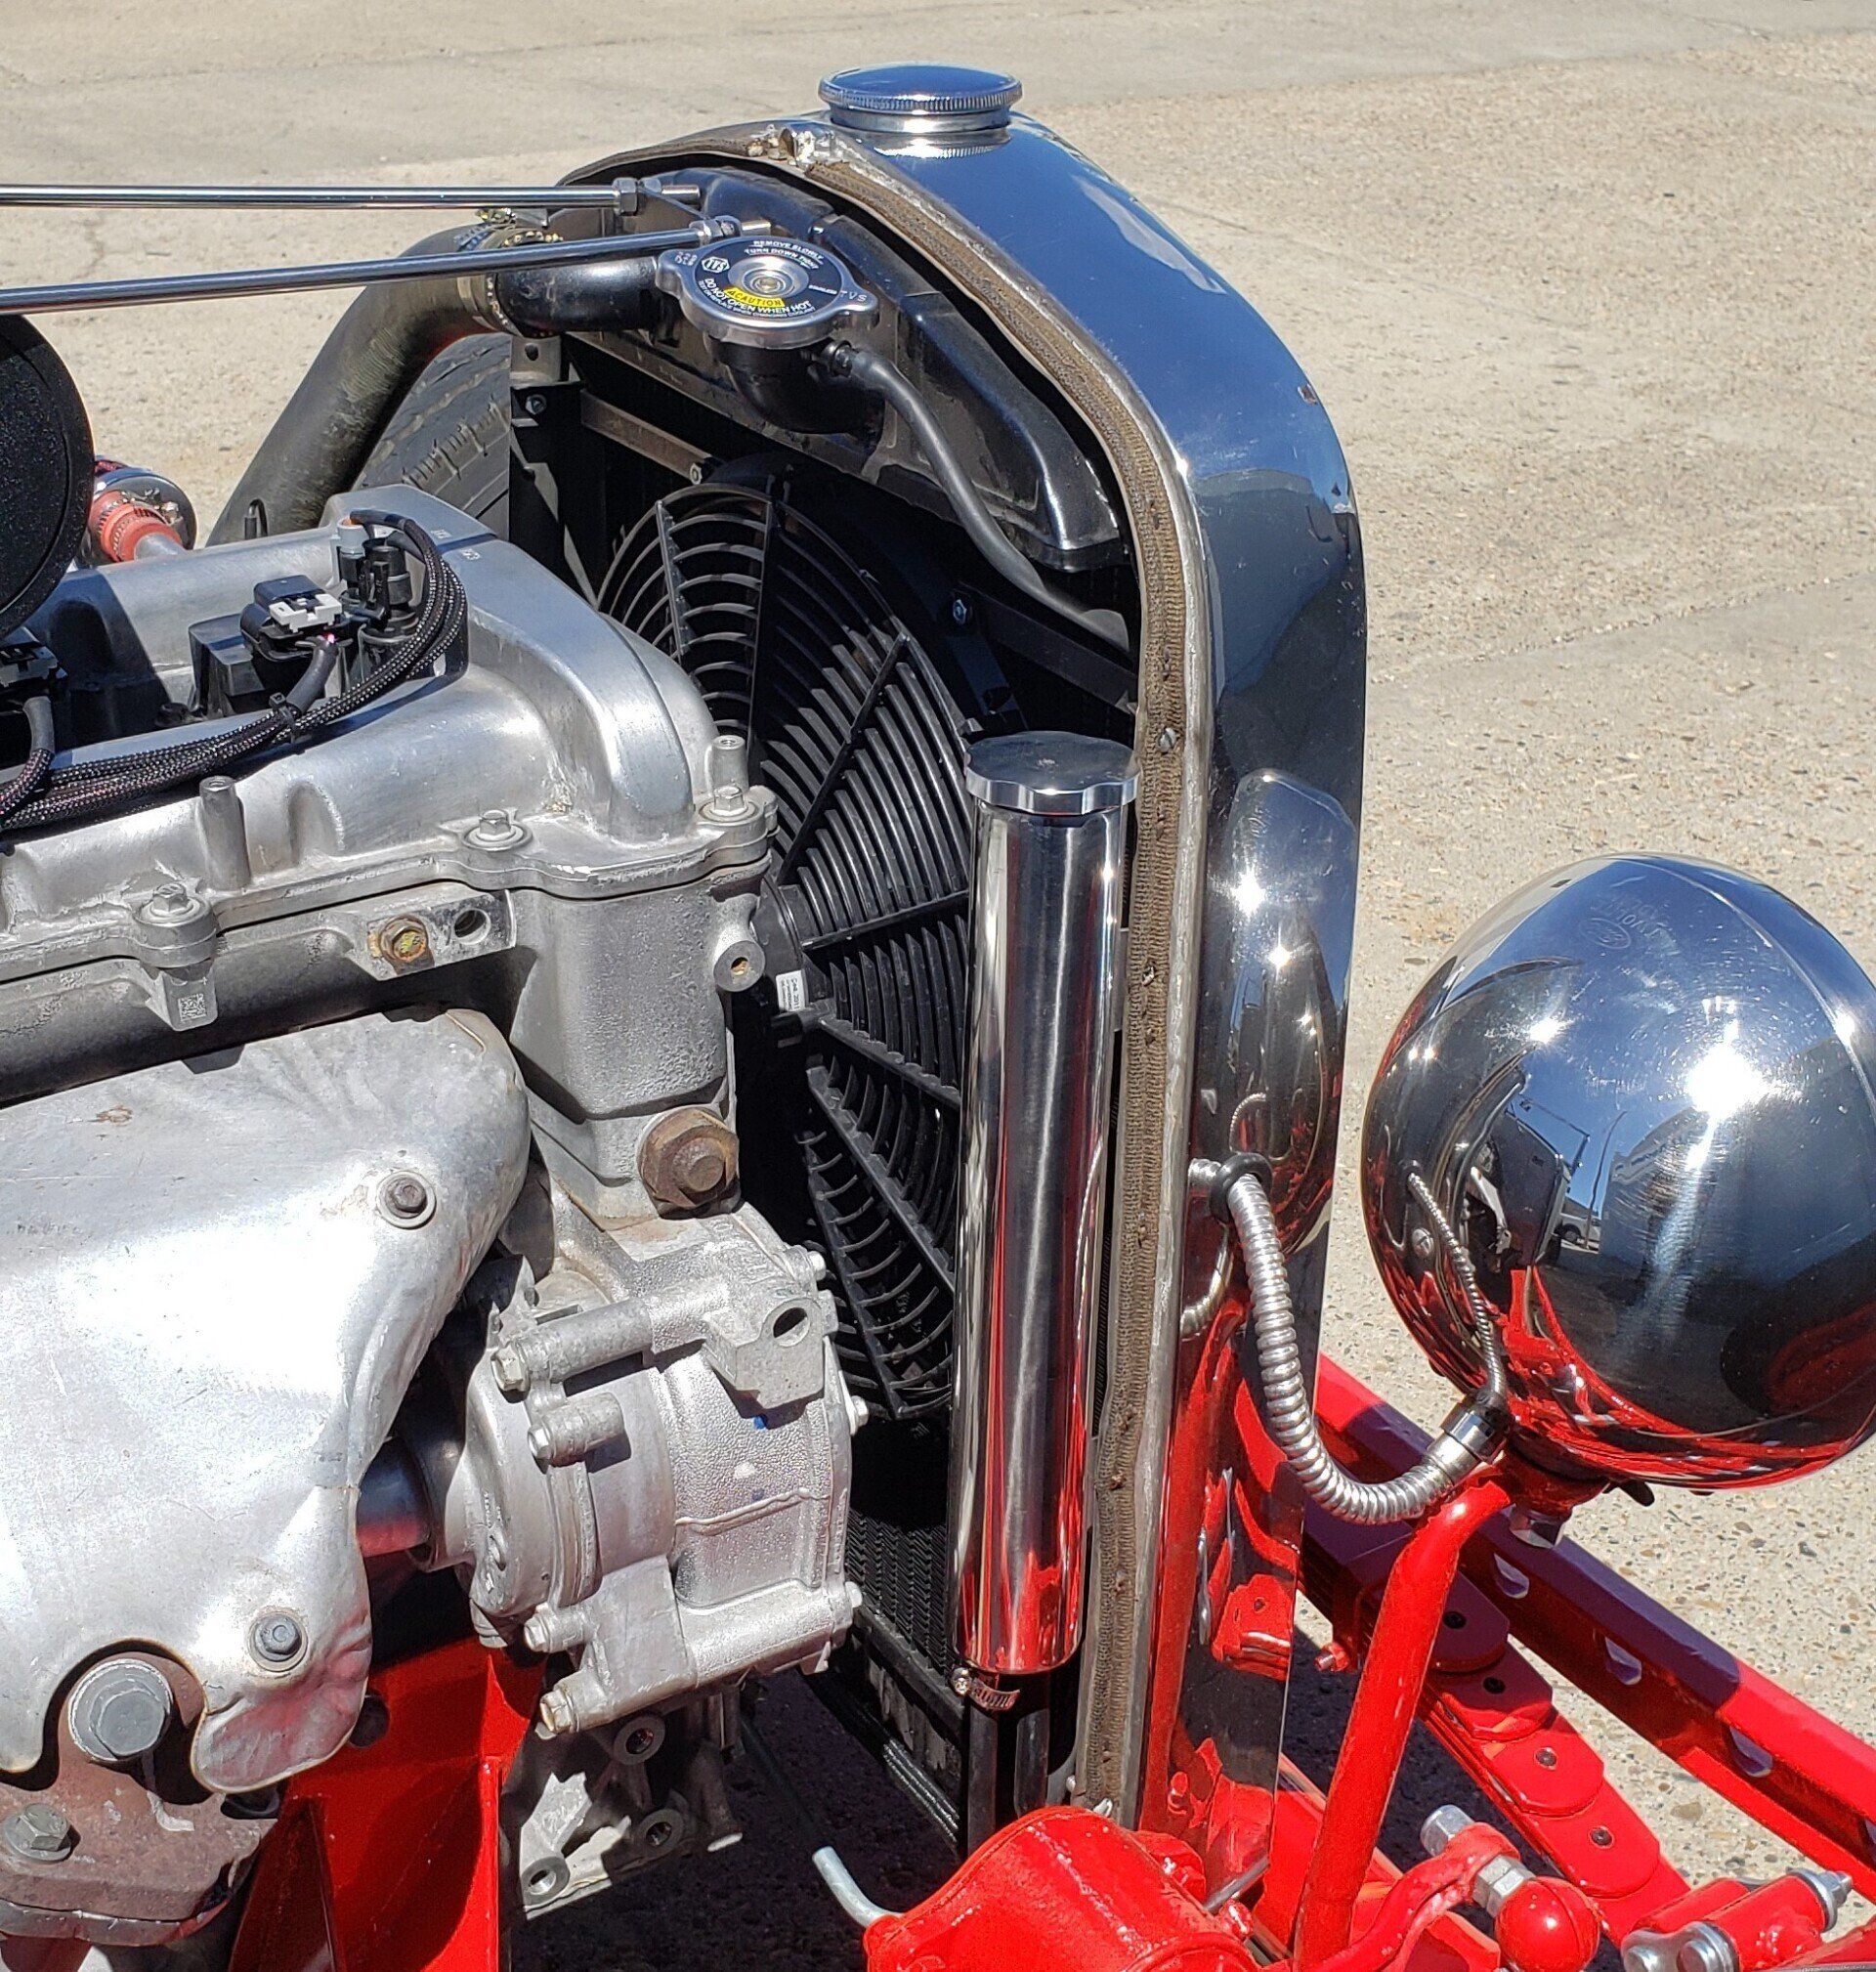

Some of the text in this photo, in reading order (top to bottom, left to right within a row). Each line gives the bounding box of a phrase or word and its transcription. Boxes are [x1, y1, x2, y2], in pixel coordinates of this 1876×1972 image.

[771, 248, 799, 258] DOWN
[704, 258, 728, 271] TVS
[704, 279, 812, 315] DO NOT OPEN WHEN HOT
[734, 292, 783, 306] CAUTION
[840, 289, 868, 302] TVS
